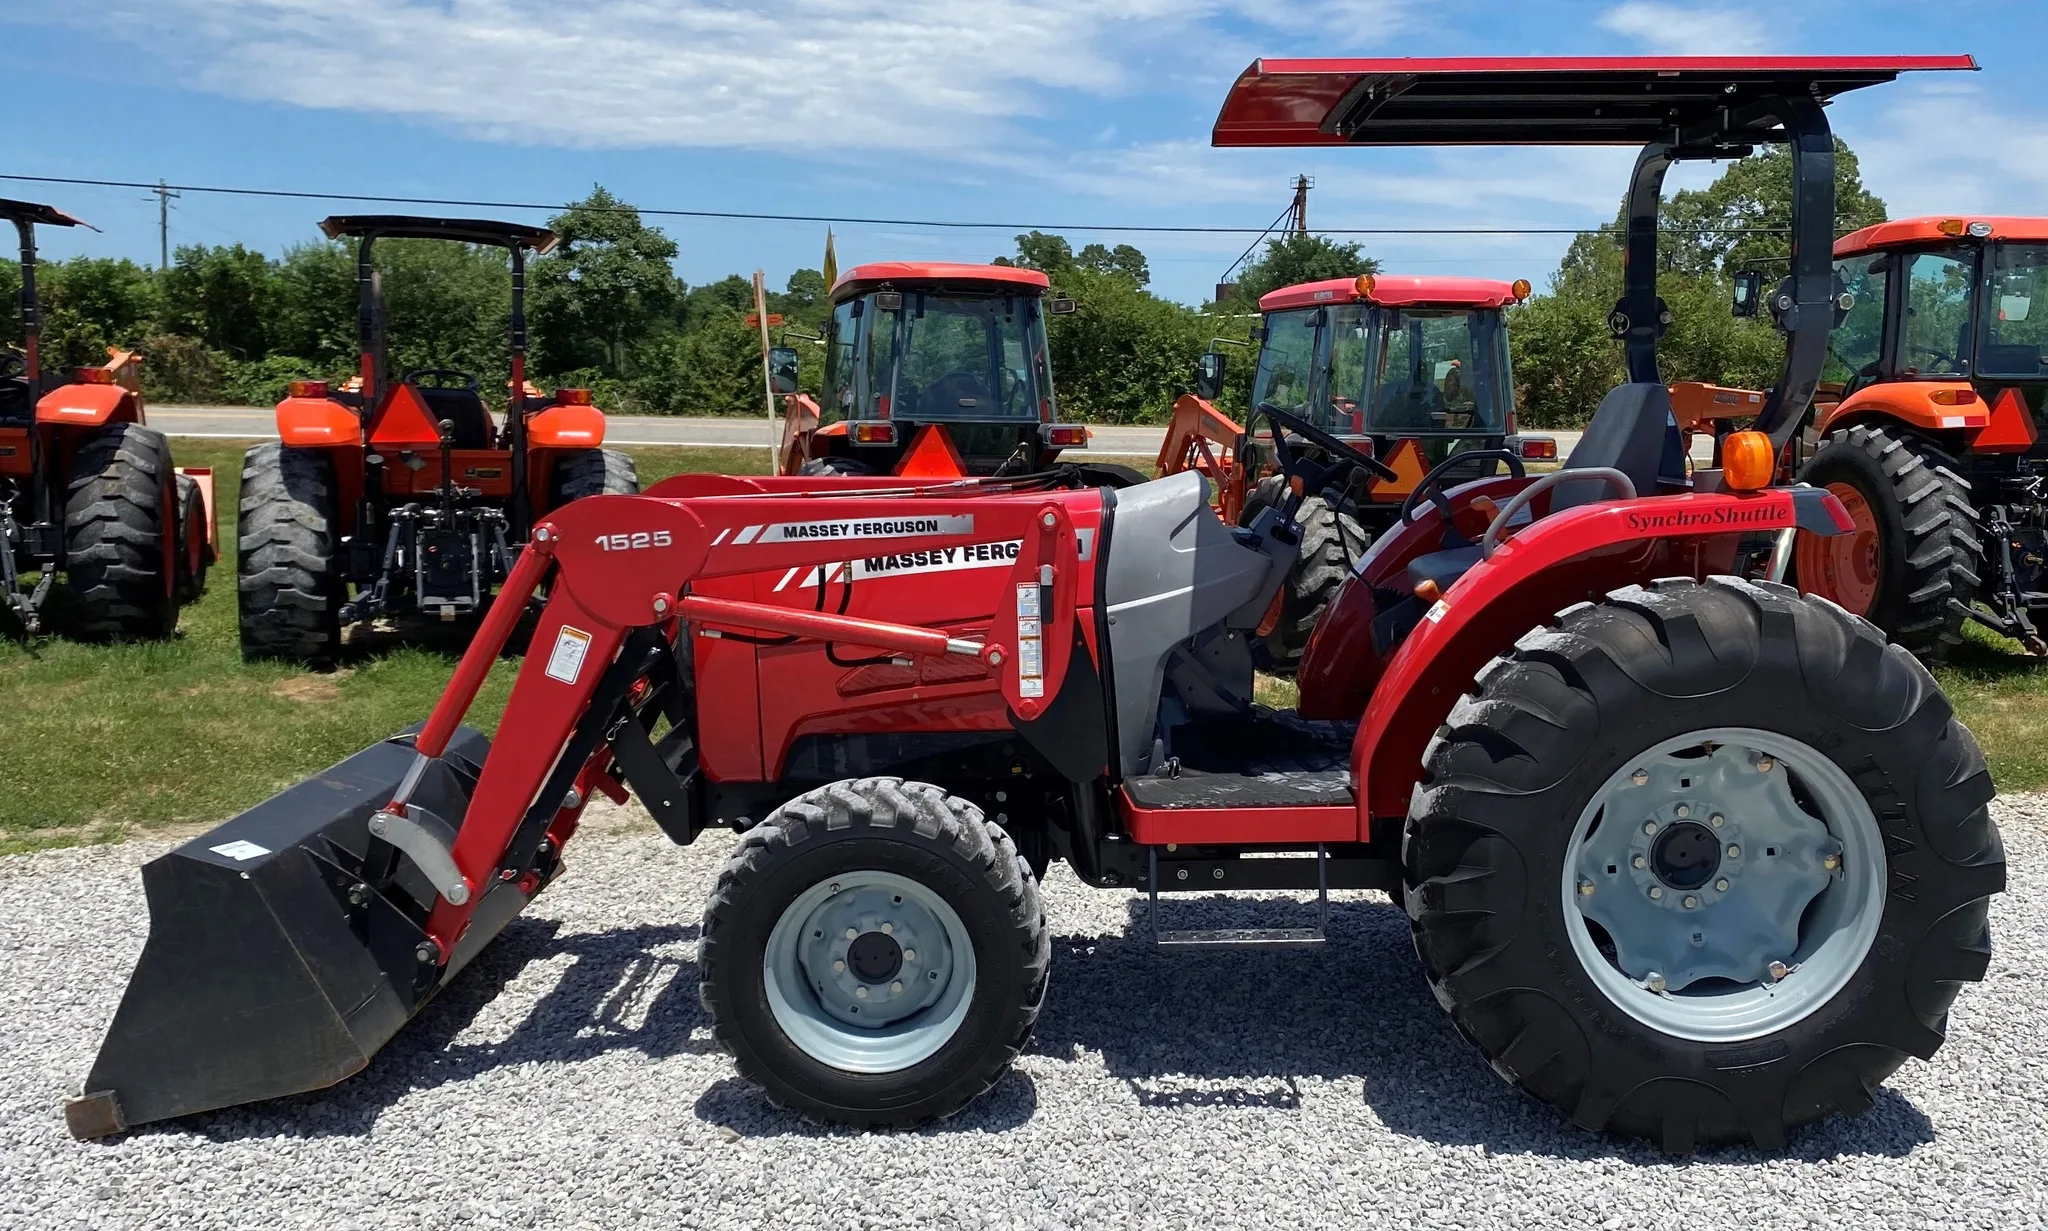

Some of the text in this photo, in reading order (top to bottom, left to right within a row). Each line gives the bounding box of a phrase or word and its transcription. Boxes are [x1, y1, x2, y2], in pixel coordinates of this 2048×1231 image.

[783, 520, 938, 538] MASSEY FERGUSON
[1627, 505, 1787, 532] SynchroShuttle
[594, 531, 672, 551] 1525
[864, 548, 957, 572] MASSEY
[1851, 753, 1919, 902] TITAN
